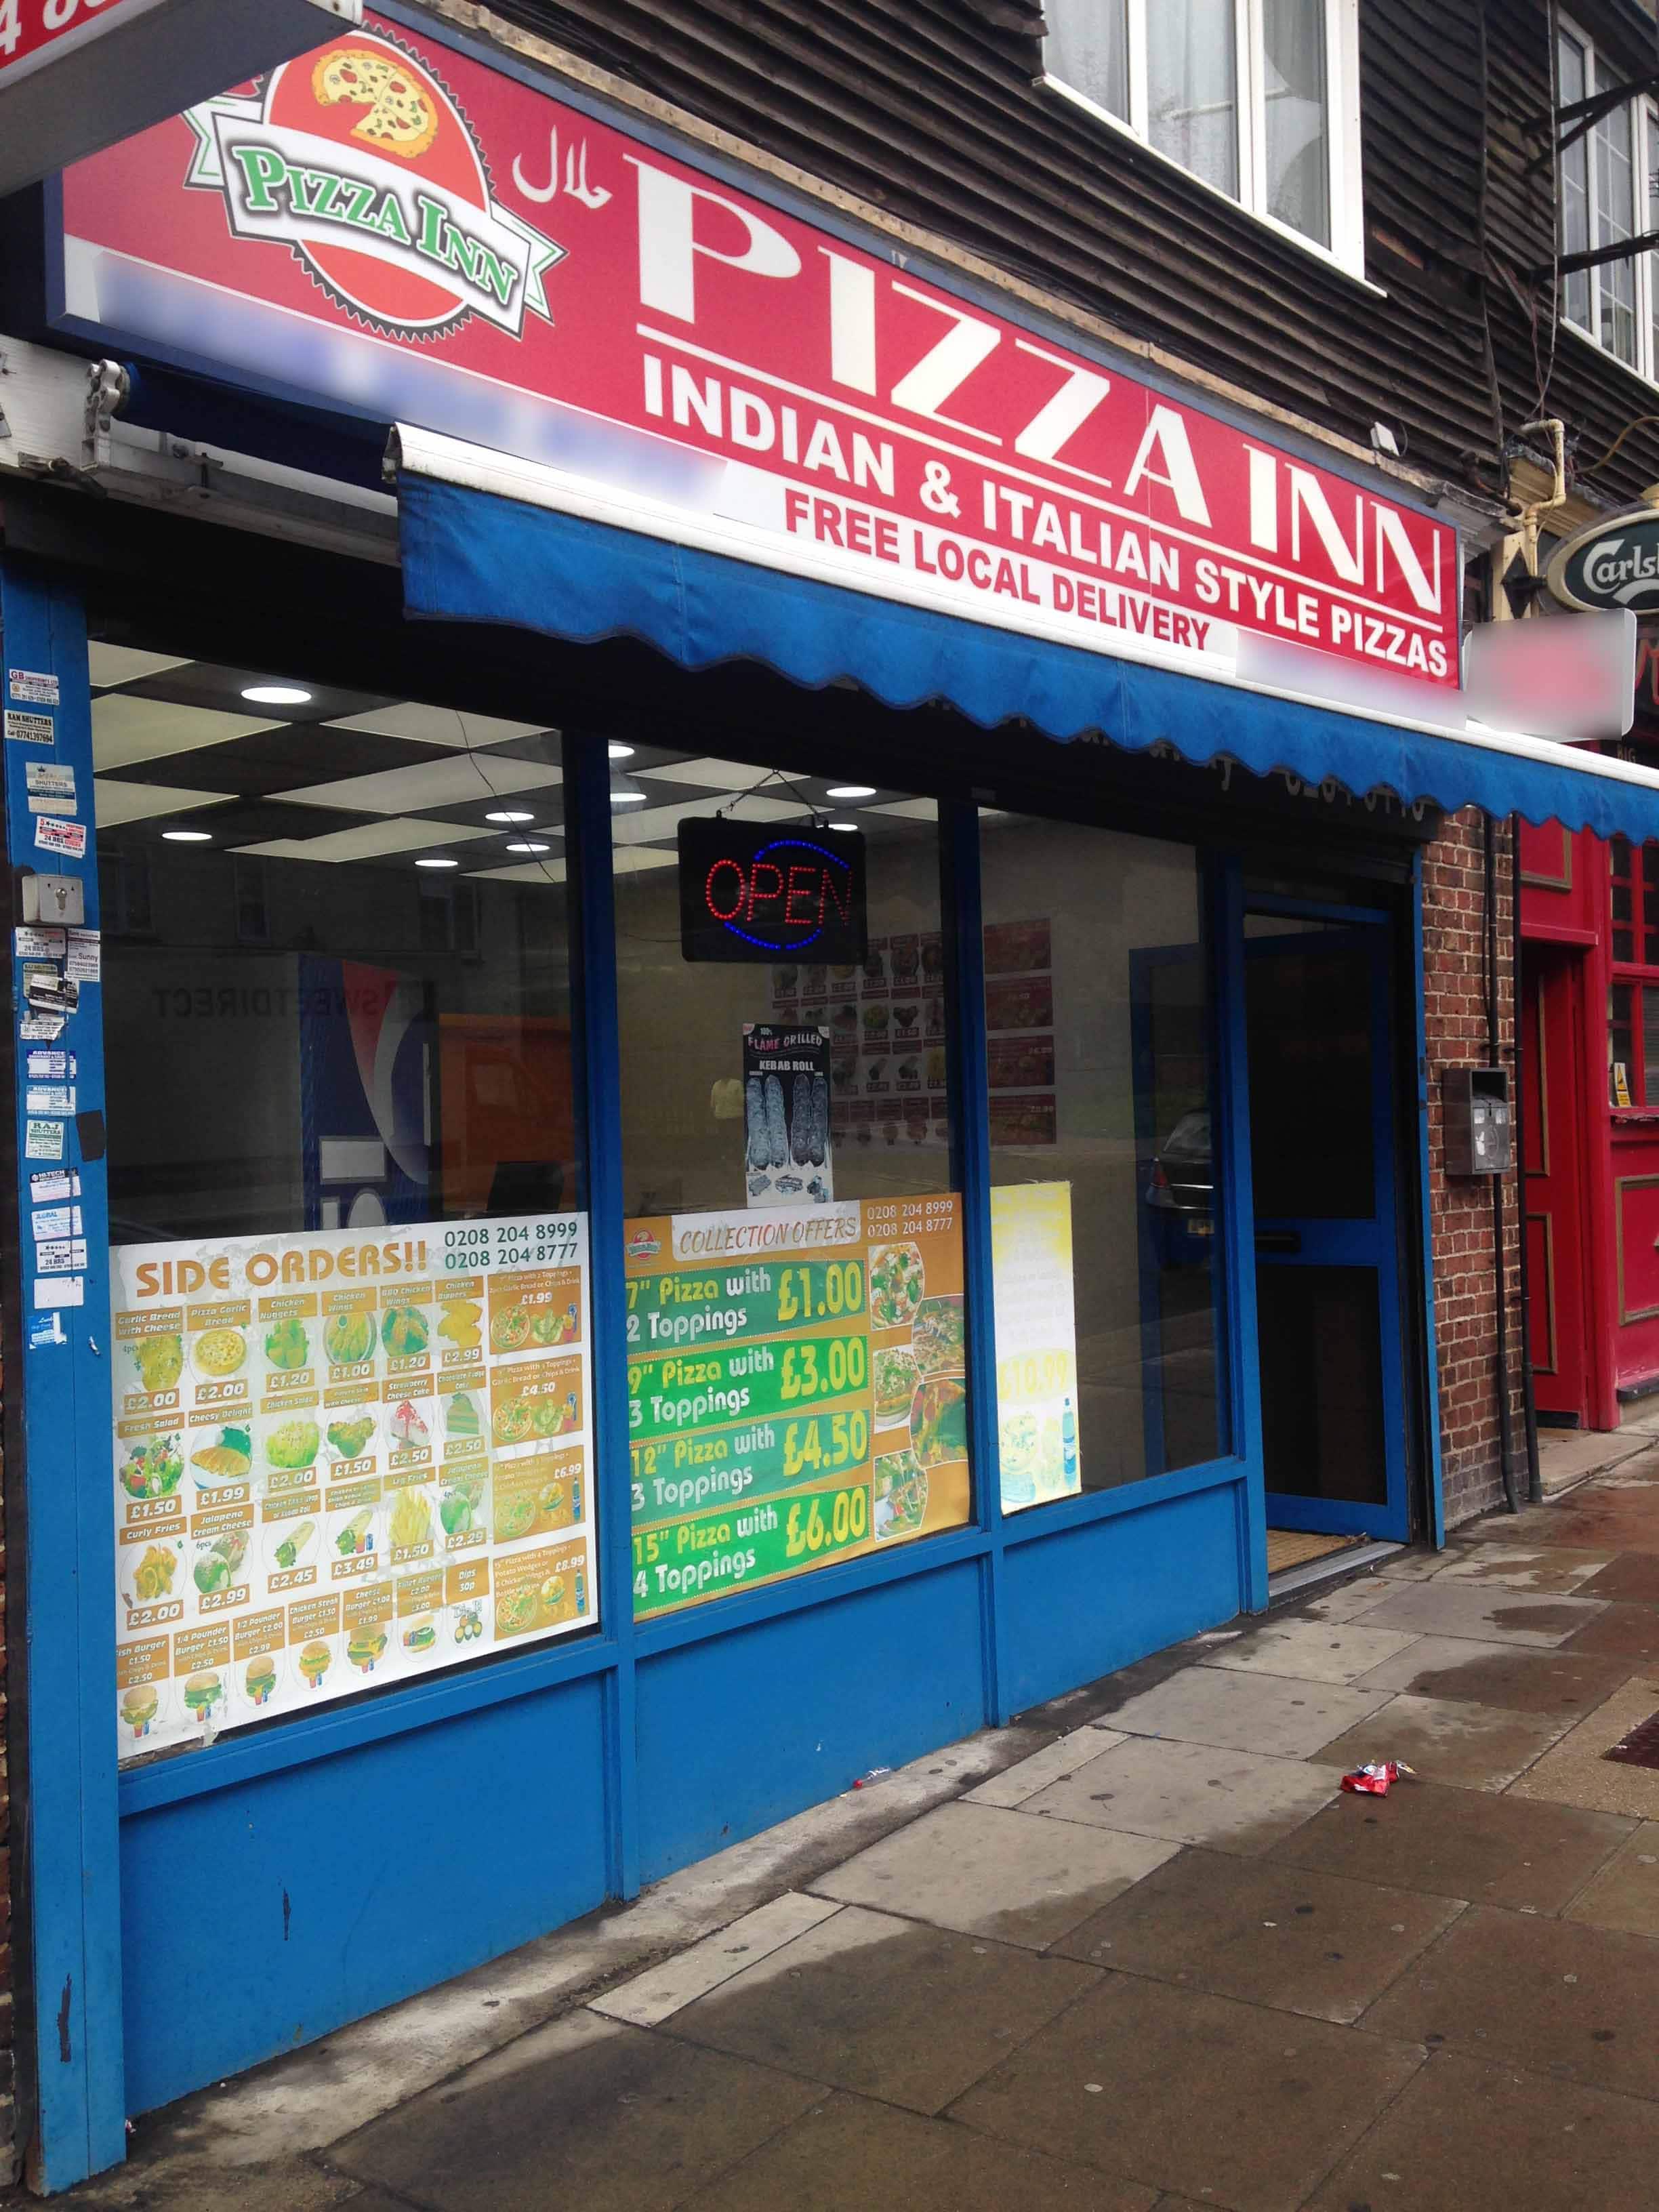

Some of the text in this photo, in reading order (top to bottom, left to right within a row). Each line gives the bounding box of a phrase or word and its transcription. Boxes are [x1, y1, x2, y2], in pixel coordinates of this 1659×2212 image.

[512, 125, 613, 209] حلال
[622, 152, 1442, 615] PIZZA INN
[643, 353, 1448, 678] INDIAN & ITALIAN STYLE PIZZAS
[785, 489, 1211, 652] FREE LOCAL DELIVERY
[1583, 539, 1659, 594] Carls
[11, 671, 24, 680] GB
[22, 714, 52, 726] SHUTTERS
[705, 859, 853, 927] OPEN
[78, 953, 98, 962] Sunny
[748, 1036, 781, 1051] FLAME
[759, 1060, 815, 1071] KEBAB ROLL
[867, 1200, 953, 1220] 0208 204 8999
[445, 1222, 578, 1248] 0208 204 8999
[679, 1216, 857, 1255] COLLECTION OFFERS
[867, 1218, 953, 1237] 0208 204 8777
[445, 1242, 578, 1269] 0208 204 8777
[136, 1240, 427, 1298] SIDE ORDERS!!
[659, 1277, 719, 1305] Pizza
[726, 1267, 772, 1297] with
[777, 1261, 862, 1322] £1.00
[520, 1292, 553, 1305] £1.99
[118, 1311, 180, 1325] Garlic Bread
[190, 1308, 217, 1317] Pizza
[119, 1323, 181, 1335] with Cheese
[626, 1307, 747, 1343] 2 Toppings
[390, 1356, 426, 1372] £1.20
[444, 1349, 480, 1363] £2.99
[333, 1364, 371, 1379] £1.00
[512, 1374, 531, 1383] Bread
[565, 1366, 581, 1374] Drink
[662, 1357, 722, 1389] Pizza
[729, 1345, 775, 1378] with
[780, 1336, 866, 1401] £3.00
[270, 1372, 310, 1389] £1.20
[521, 1381, 556, 1397] £4.50
[196, 1382, 245, 1401] £2.00
[413, 1387, 430, 1396] Cake
[126, 1392, 176, 1411] £2.00
[629, 1386, 750, 1428] 3 Toppings
[124, 1417, 179, 1433] Fresh Salad
[189, 1408, 253, 1423] Cheesy Delight
[445, 1440, 482, 1456] £2.50
[674, 1437, 729, 1469] Pizza
[734, 1422, 776, 1454] with
[783, 1409, 867, 1477] £4.50
[390, 1448, 429, 1466] £2.50
[333, 1459, 371, 1477] £1.50
[554, 1463, 582, 1479] £6.99
[269, 1469, 313, 1489] £2.00
[631, 1465, 753, 1511] 3 Toppings
[200, 1487, 245, 1505] £1.99
[130, 1498, 176, 1519] £1.50
[126, 1521, 181, 1540] Curly Fries
[192, 1518, 252, 1538] Cream Cheese
[677, 1521, 731, 1555] Pizza
[737, 1504, 779, 1539] with
[785, 1487, 867, 1558] £6.00
[394, 1543, 430, 1561] £1.50
[333, 1556, 375, 1576] £3.49
[555, 1554, 585, 1573] £8.99
[633, 1548, 756, 1598] 4 Toppings
[270, 1569, 314, 1589] £2.45
[459, 1568, 477, 1580] Dips
[200, 1588, 247, 1610] £2.99
[289, 1597, 339, 1615] Chicken Steak
[346, 1600, 371, 1612] Burger
[128, 1603, 180, 1627] £2.00
[249, 1612, 281, 1625] Pounder
[292, 1612, 316, 1624] Burger
[190, 1626, 227, 1641] Pounder
[234, 1628, 261, 1641] Burger
[262, 1622, 283, 1633] £2.00
[304, 1627, 325, 1639] £2.50
[134, 1640, 167, 1653] Burger
[175, 1643, 205, 1656] Burger
[207, 1636, 229, 1647] £1.50
[249, 1643, 271, 1655] £2.99
[129, 1654, 152, 1665] £1.50
[191, 1658, 214, 1670] £2.50
[128, 1672, 152, 1684] £2.50
